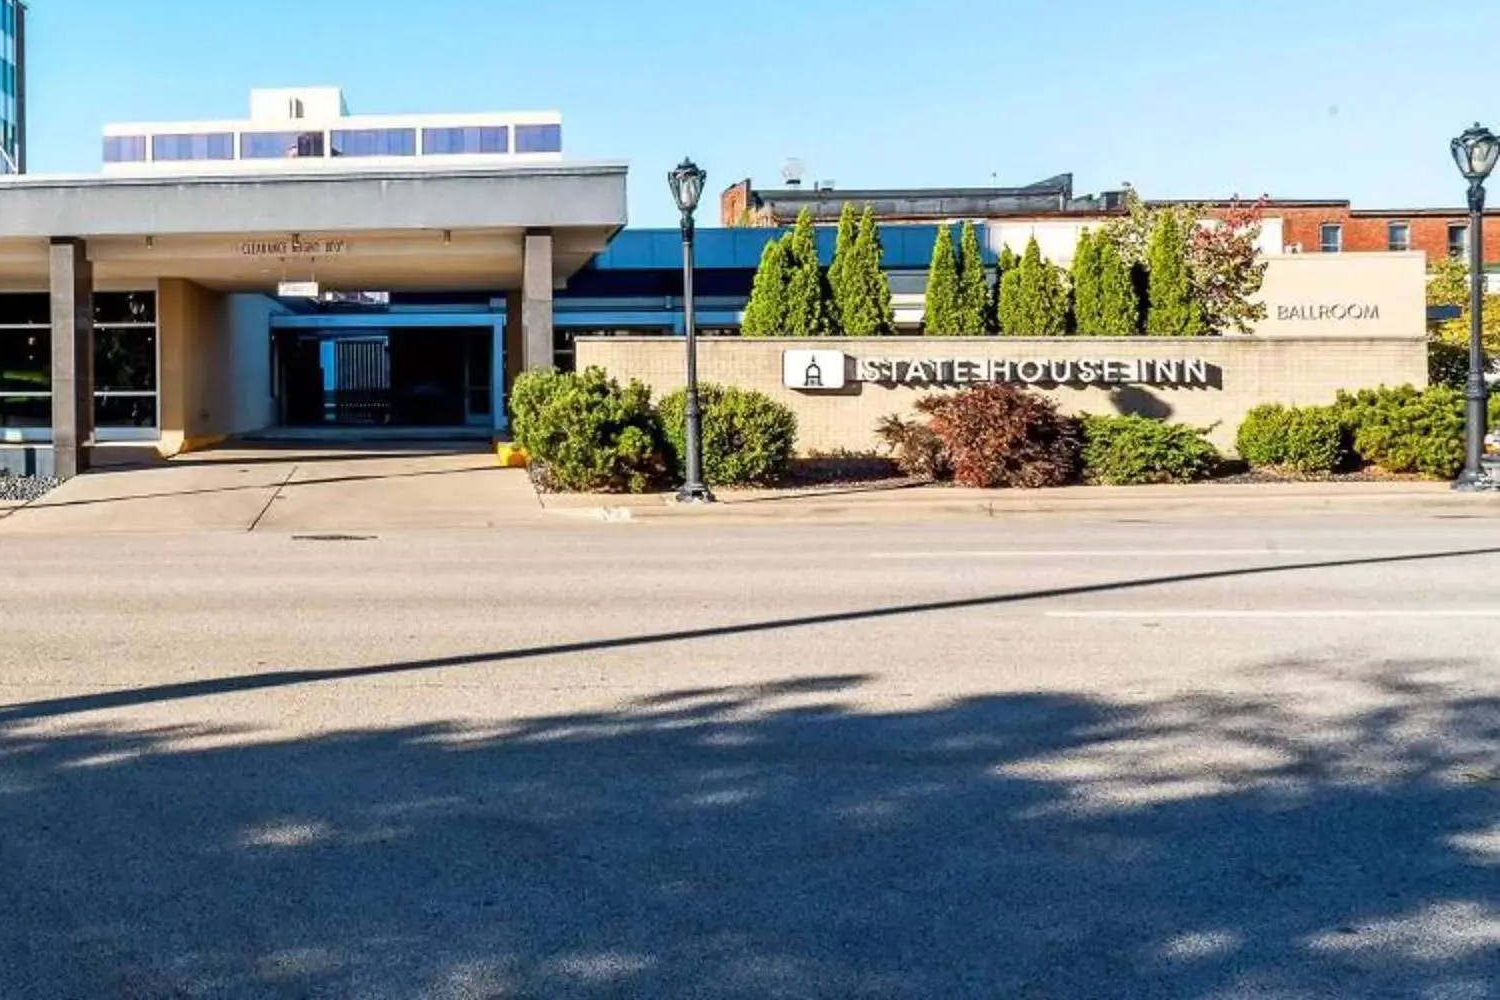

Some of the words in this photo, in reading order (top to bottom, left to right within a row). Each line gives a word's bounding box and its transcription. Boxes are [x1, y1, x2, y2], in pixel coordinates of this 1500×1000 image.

[1277, 303, 1380, 321] BALLROOM
[862, 357, 973, 382] STATE
[990, 358, 1118, 383] HOUSE
[1138, 357, 1208, 383] INN
